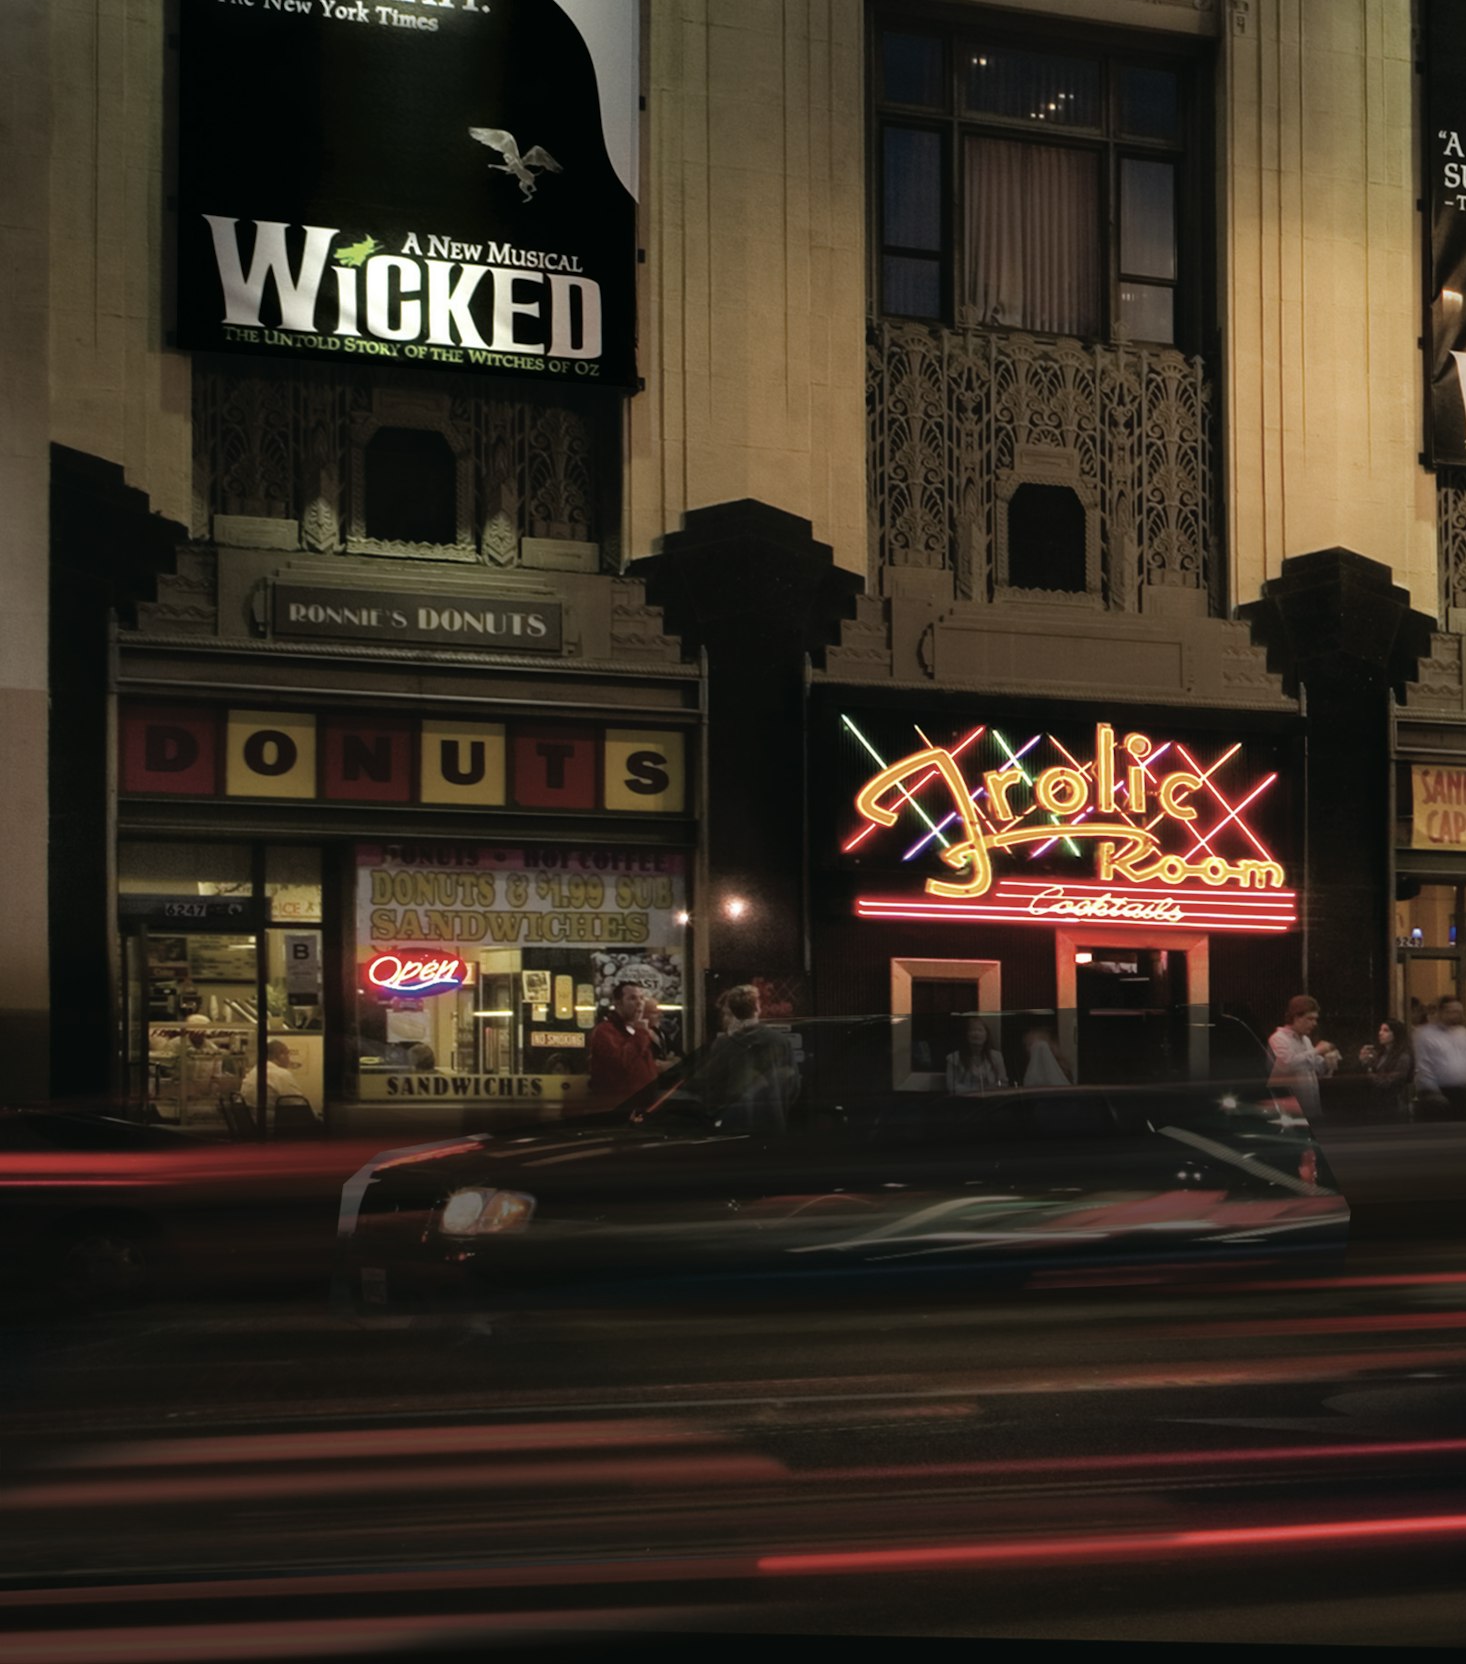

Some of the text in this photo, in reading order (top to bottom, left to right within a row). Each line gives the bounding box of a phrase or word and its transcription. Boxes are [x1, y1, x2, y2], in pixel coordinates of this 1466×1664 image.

[374, 5, 440, 32] Times
[401, 232, 422, 256] A
[288, 602, 548, 637] RONNIE'S DONUTS
[145, 725, 671, 796] DONUTS
[856, 722, 1205, 898] Frolic
[524, 849, 570, 869] HOT
[578, 851, 667, 873] COFFEE
[1099, 838, 1285, 889] Room
[370, 870, 674, 909] DONUTS & $1.99 SUB
[1028, 885, 1185, 923] Cocktails
[370, 909, 649, 943] SANDWICHES
[293, 943, 310, 959] B
[368, 954, 460, 991] Open
[386, 1076, 543, 1097] SANDWICHES
